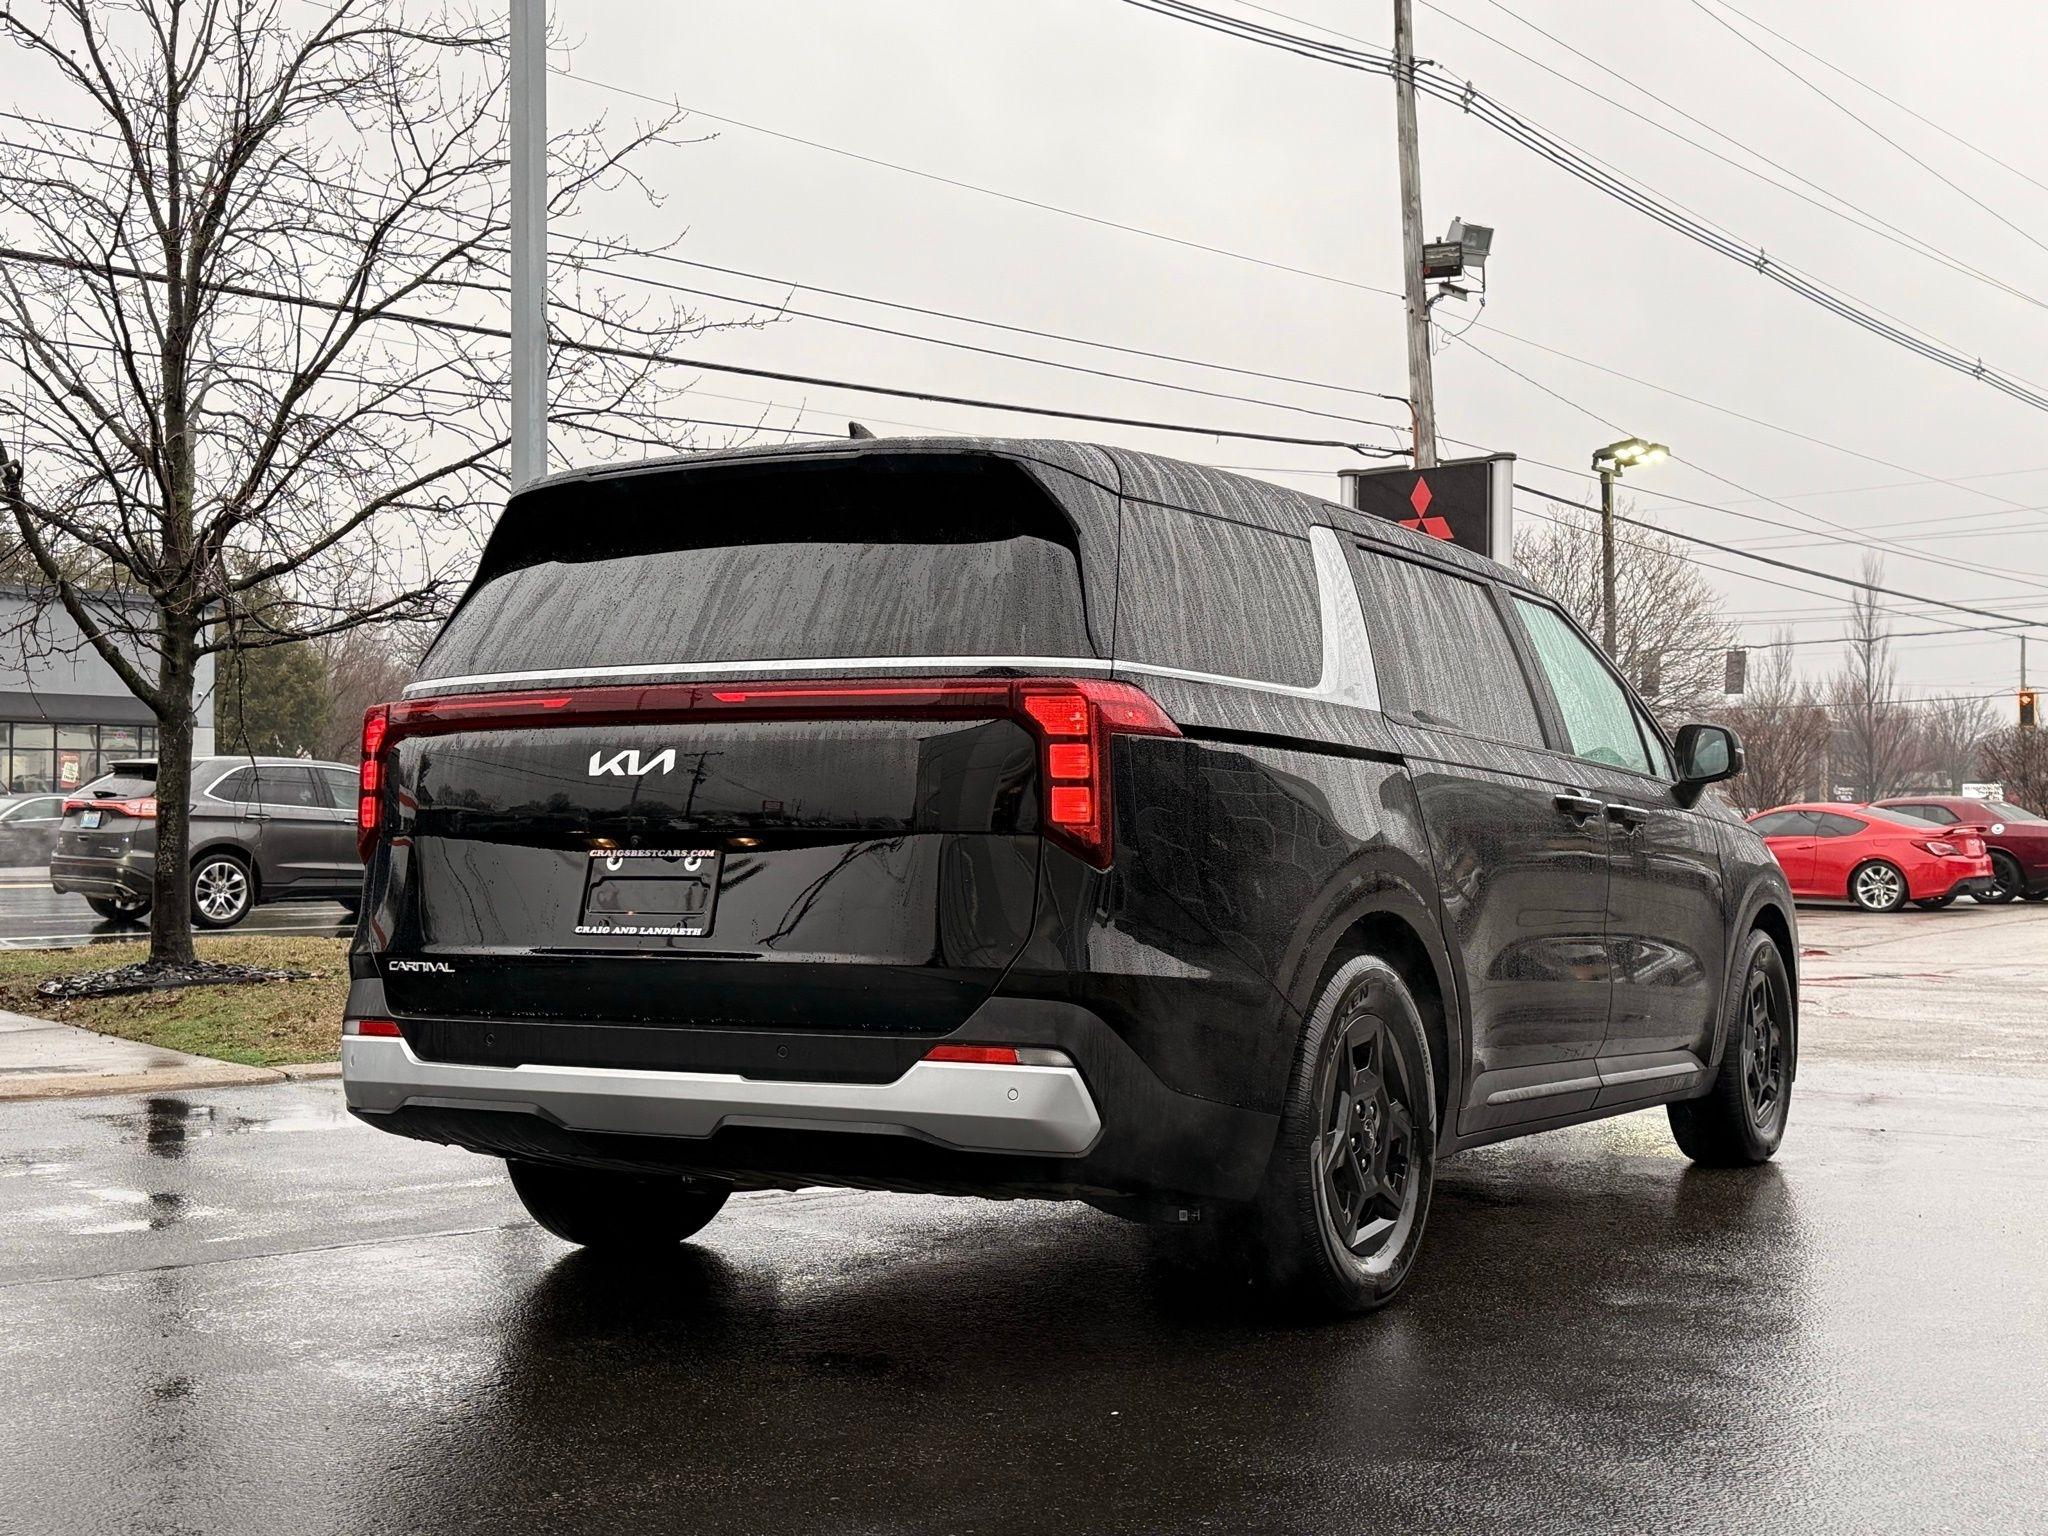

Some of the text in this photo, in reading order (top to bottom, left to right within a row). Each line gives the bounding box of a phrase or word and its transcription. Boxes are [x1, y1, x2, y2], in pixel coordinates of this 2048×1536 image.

[589, 749, 676, 776] KIA
[589, 849, 715, 857] CRAIGSBESTCARS.COM
[574, 925, 703, 936] CRAIG AND LANDRETH
[389, 961, 456, 972] CARNIVAL
